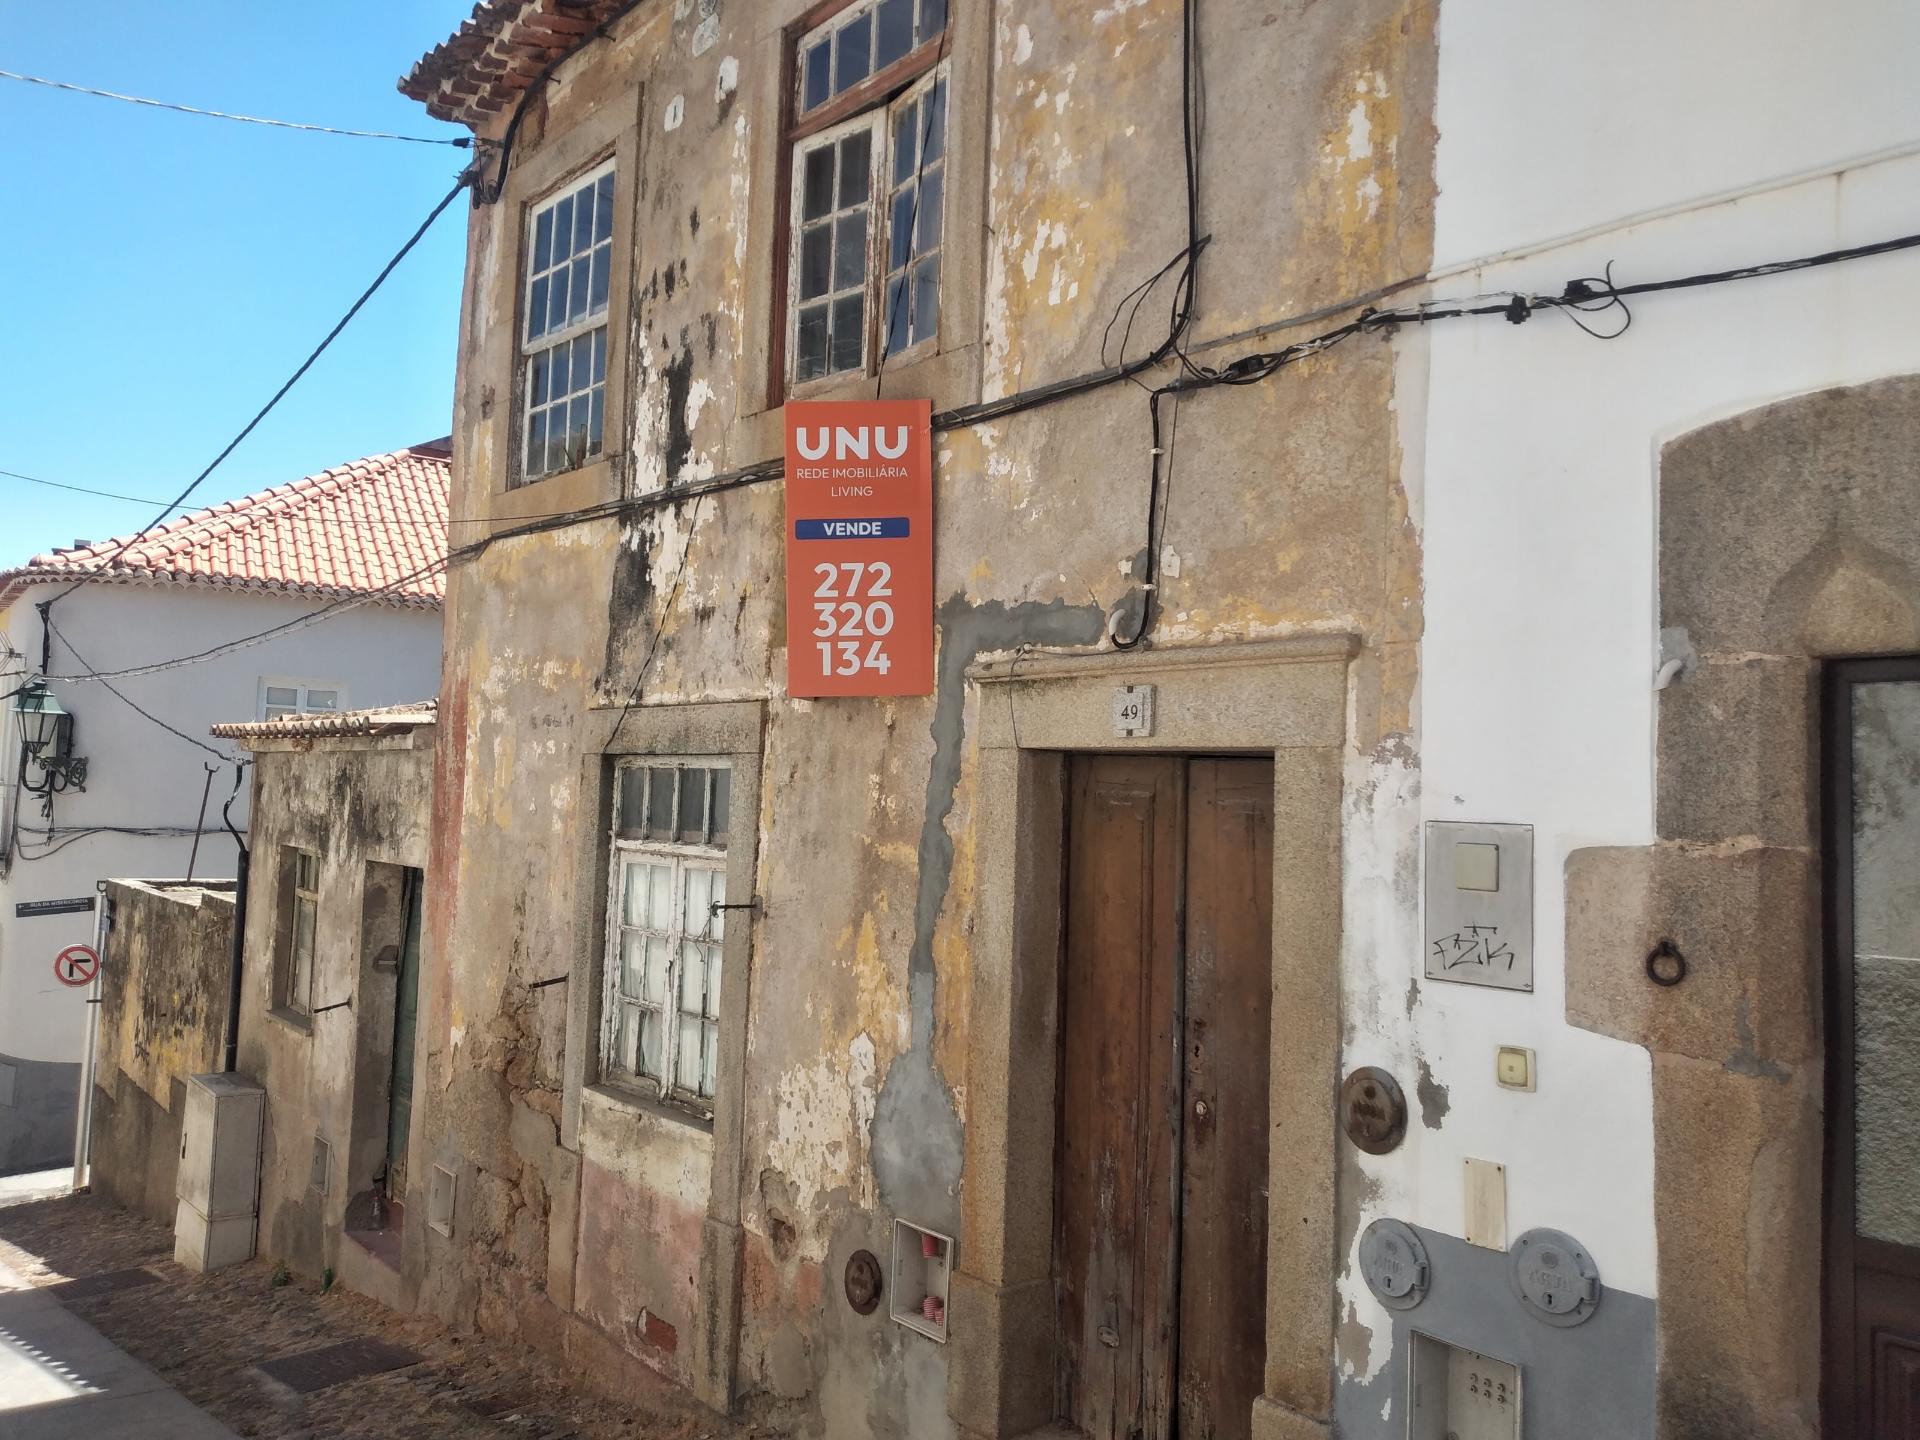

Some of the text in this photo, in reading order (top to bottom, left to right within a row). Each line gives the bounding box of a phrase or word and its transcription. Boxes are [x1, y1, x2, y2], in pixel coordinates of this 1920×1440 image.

[796, 425, 908, 461] UNU
[796, 468, 830, 479] REDE
[831, 486, 873, 497] LIVING
[823, 522, 882, 536] VENDE
[814, 561, 892, 598] 272
[812, 601, 894, 637] 320
[816, 640, 891, 676] 134
[1120, 704, 1138, 720] 49
